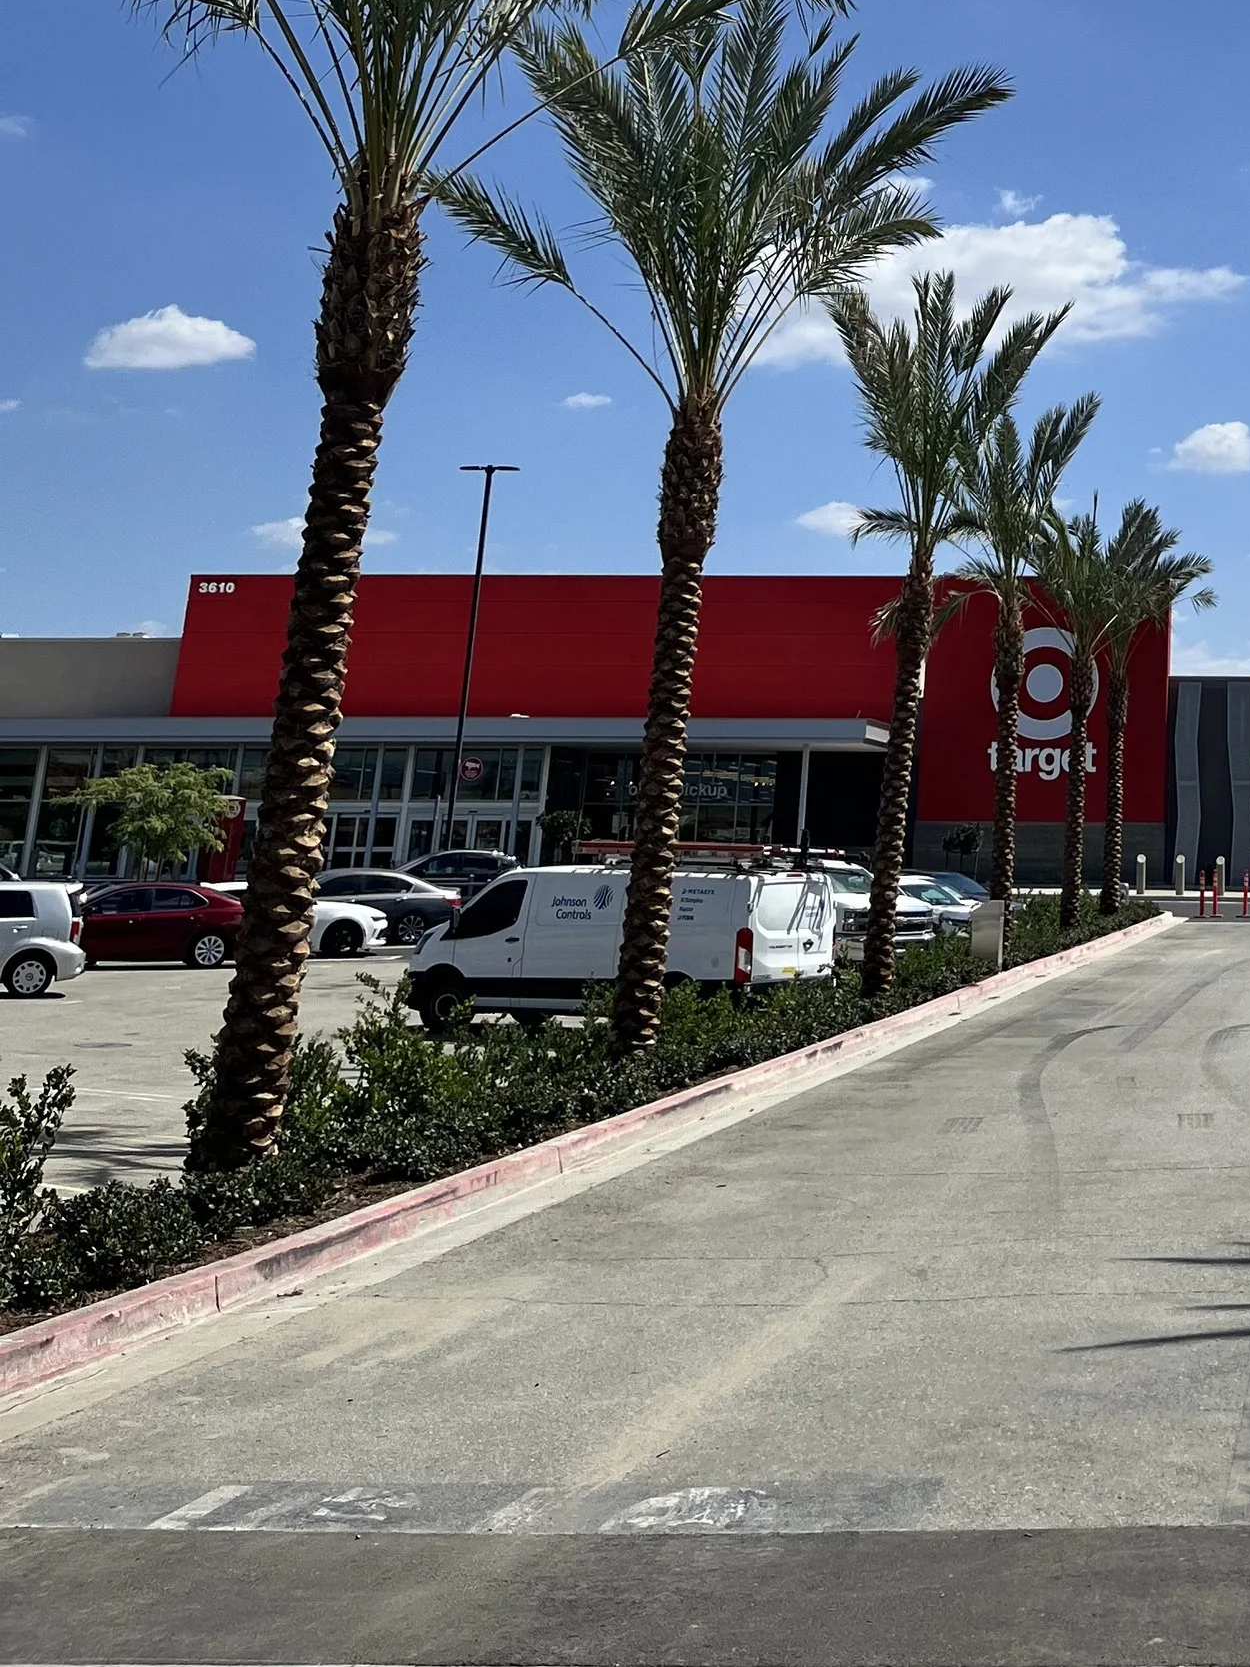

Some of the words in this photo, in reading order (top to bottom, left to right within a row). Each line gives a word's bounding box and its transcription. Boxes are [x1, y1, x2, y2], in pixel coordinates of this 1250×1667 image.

[198, 582, 236, 594] 3610
[551, 896, 587, 908] Johnson
[556, 909, 592, 920] Controls
